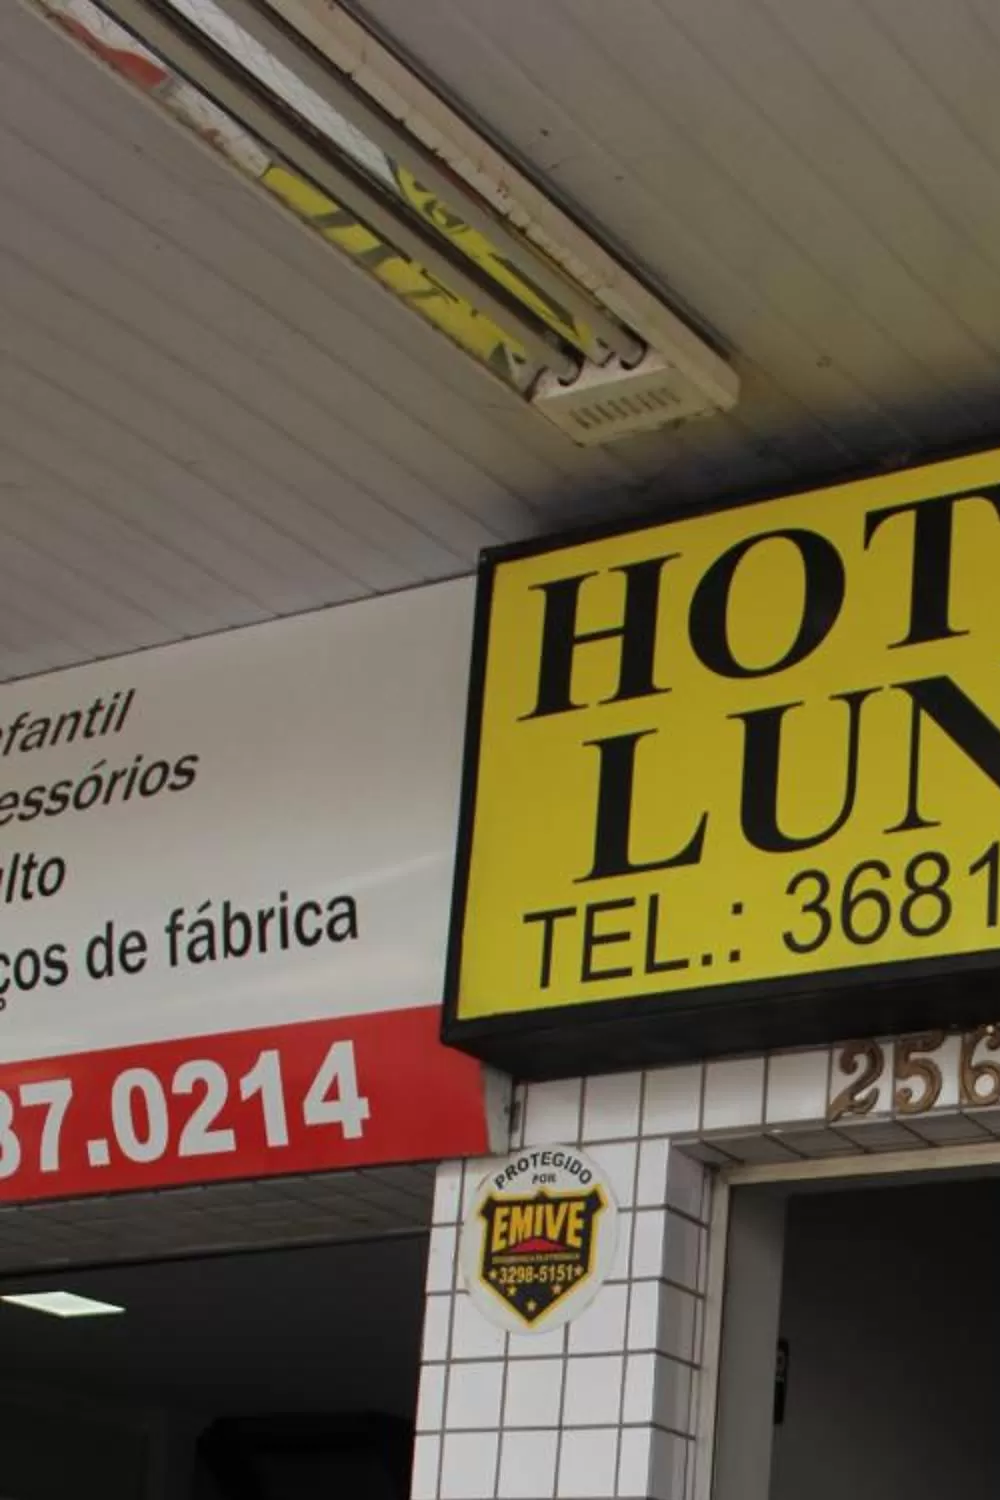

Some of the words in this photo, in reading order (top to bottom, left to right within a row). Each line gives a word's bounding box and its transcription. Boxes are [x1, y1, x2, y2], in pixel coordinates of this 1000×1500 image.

[0, 688, 136, 757] fantil
[0, 753, 200, 827] essórios
[0, 851, 66, 903] lto
[86, 920, 147, 981] de
[166, 891, 359, 967] fábrica
[522, 892, 744, 989] TEL.:
[494, 1151, 593, 1190] PROTEGIDO
[532, 1173, 557, 1184] POR
[491, 1200, 586, 1253] EMIVE
